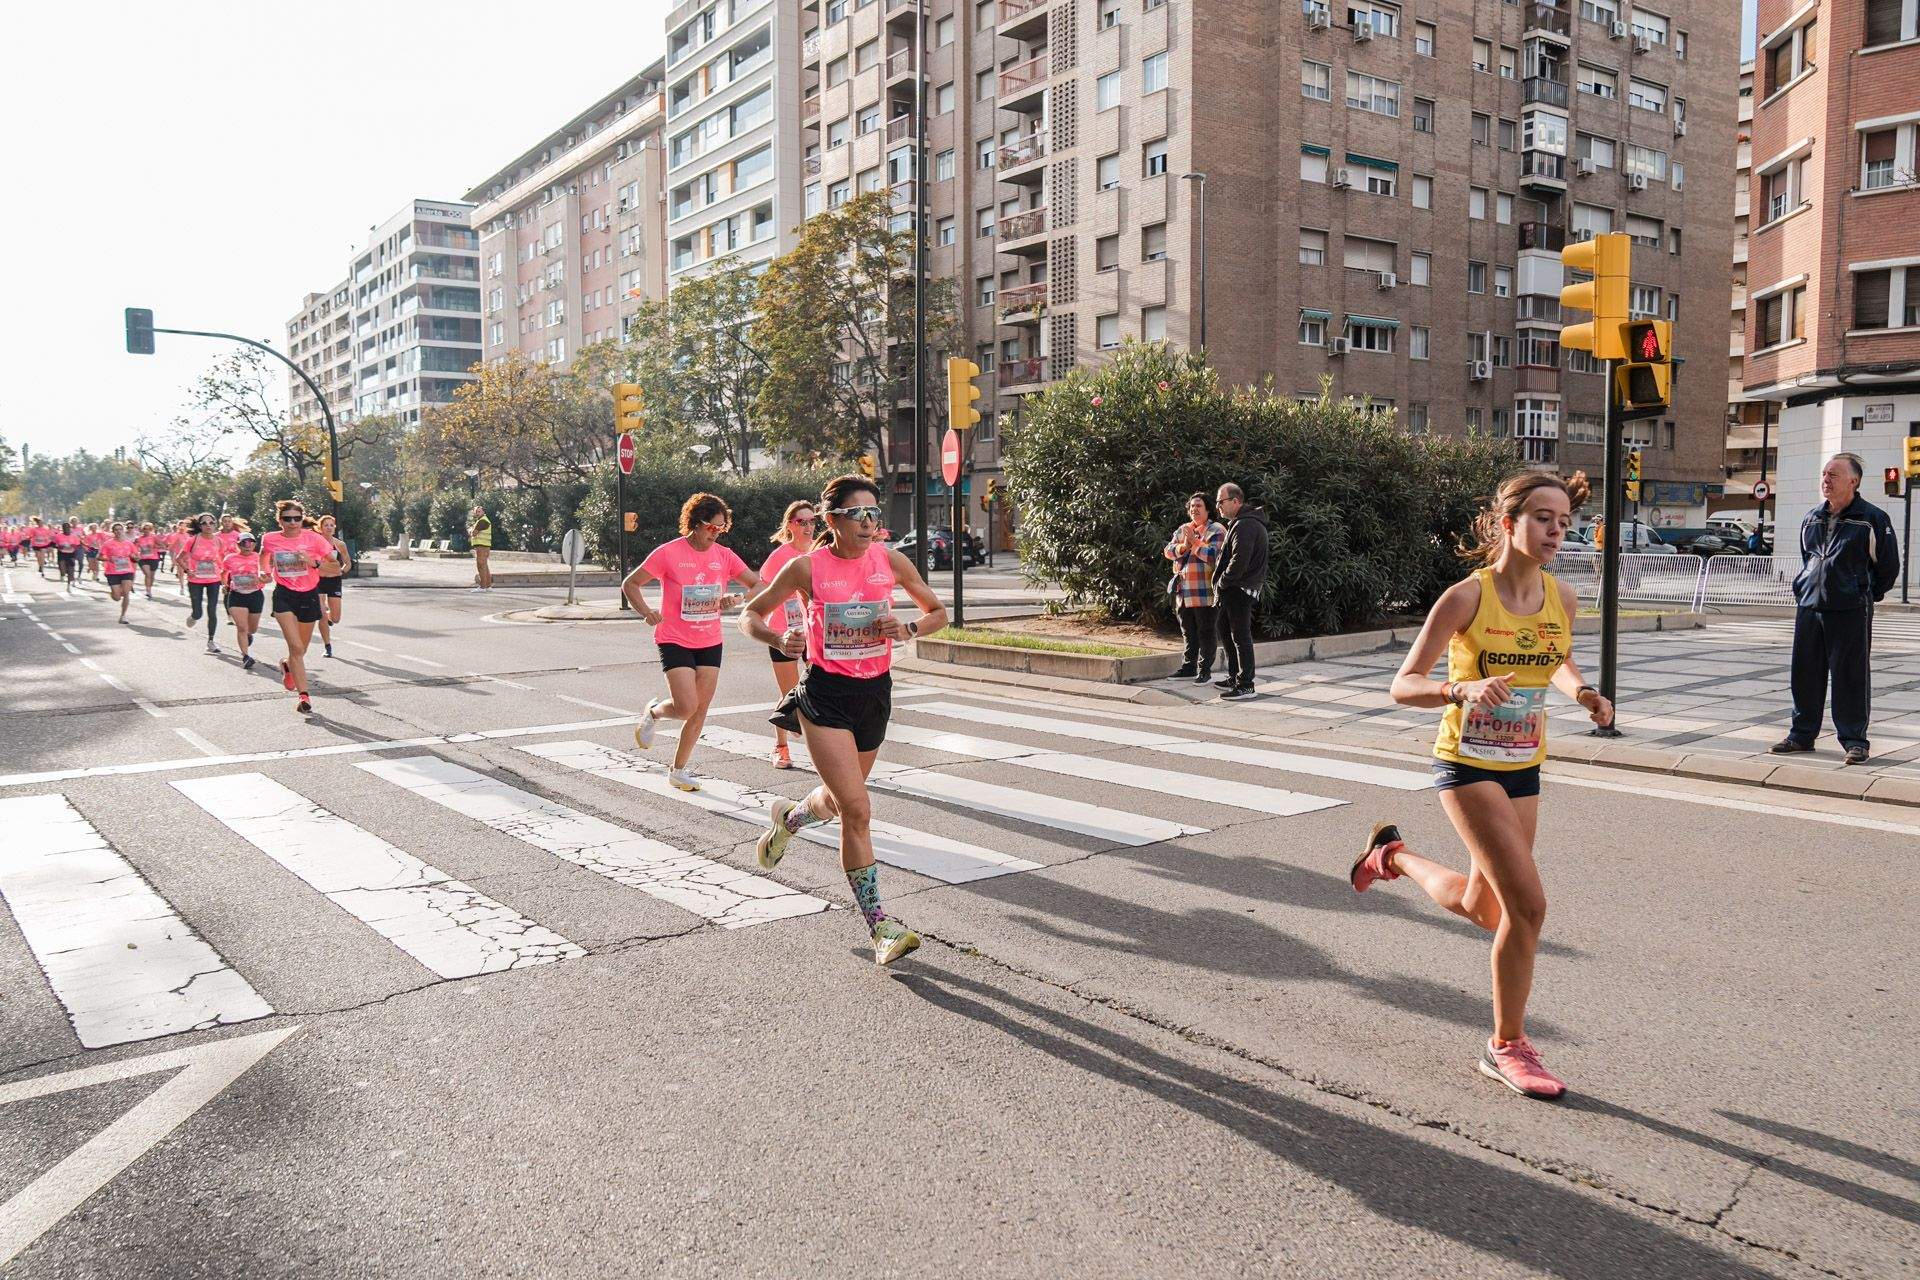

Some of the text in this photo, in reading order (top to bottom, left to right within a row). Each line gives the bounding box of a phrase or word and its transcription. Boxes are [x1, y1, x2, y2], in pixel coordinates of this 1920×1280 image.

[620, 449, 633, 458] STOP
[820, 580, 848, 589] OYSHO
[1484, 627, 1515, 636] Alcampo
